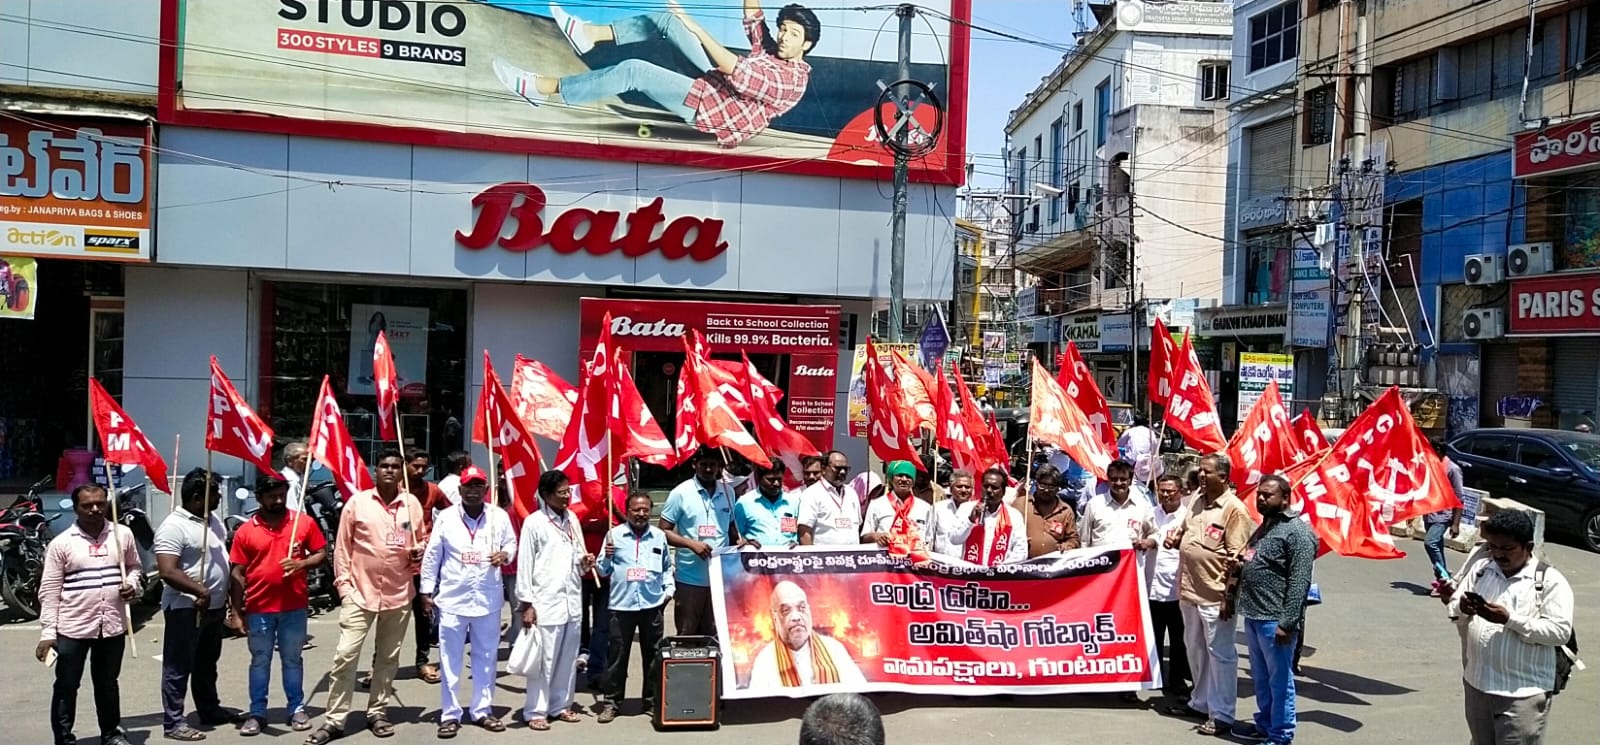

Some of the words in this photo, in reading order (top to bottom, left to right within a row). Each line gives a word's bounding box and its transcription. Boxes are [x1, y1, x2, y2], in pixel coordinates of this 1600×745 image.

[278, 0, 466, 37] STUDIO
[280, 33, 313, 47] 300
[315, 37, 378, 54] STYLES
[384, 44, 393, 56] 9
[400, 46, 462, 63] BRANDS
[28, 206, 77, 216] JANAPRIYA
[79, 209, 103, 217] BAGS
[113, 211, 142, 219] SHOES
[455, 181, 728, 261] Bata
[7, 227, 76, 247] action
[87, 236, 136, 246] sparx
[1519, 289, 1585, 318] PARIS
[610, 316, 686, 337] Bata
[706, 317, 731, 326] Back
[733, 319, 743, 327] to
[746, 319, 778, 328] School
[780, 320, 829, 328] Collection
[1242, 314, 1265, 329] KHADI
[706, 333, 731, 344] Kills
[734, 334, 769, 345] 99.9%
[772, 334, 833, 346] Bacteria.
[793, 365, 834, 376] Bata
[791, 407, 833, 415] Collection
[825, 555, 856, 570] వివక్ష
[871, 581, 935, 611] ఆంధ్ర
[940, 582, 1030, 612] ద్రోహి...
[883, 657, 1023, 683] వామపక్షాలు,
[1028, 654, 1144, 678] గుంటూరు
